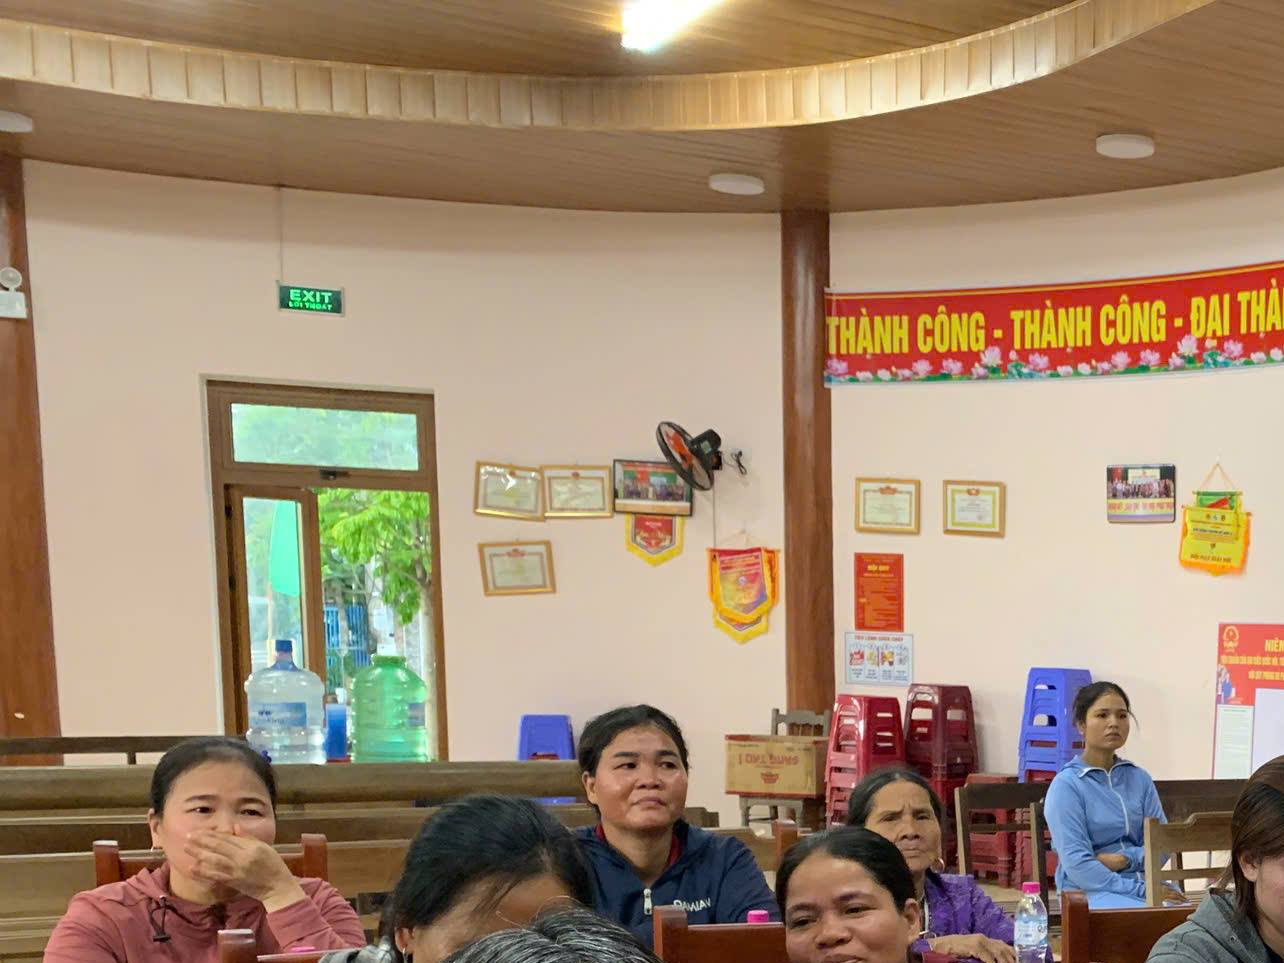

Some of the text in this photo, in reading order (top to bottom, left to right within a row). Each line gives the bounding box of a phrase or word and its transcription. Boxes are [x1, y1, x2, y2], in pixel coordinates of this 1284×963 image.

[290, 289, 332, 303] EXIT
[827, 302, 909, 356] THÀNH
[917, 305, 986, 354] CÔNG
[1011, 301, 1092, 351] THÀNH
[1100, 295, 1168, 345] CÔNG
[1191, 296, 1231, 348] ĐẠI
